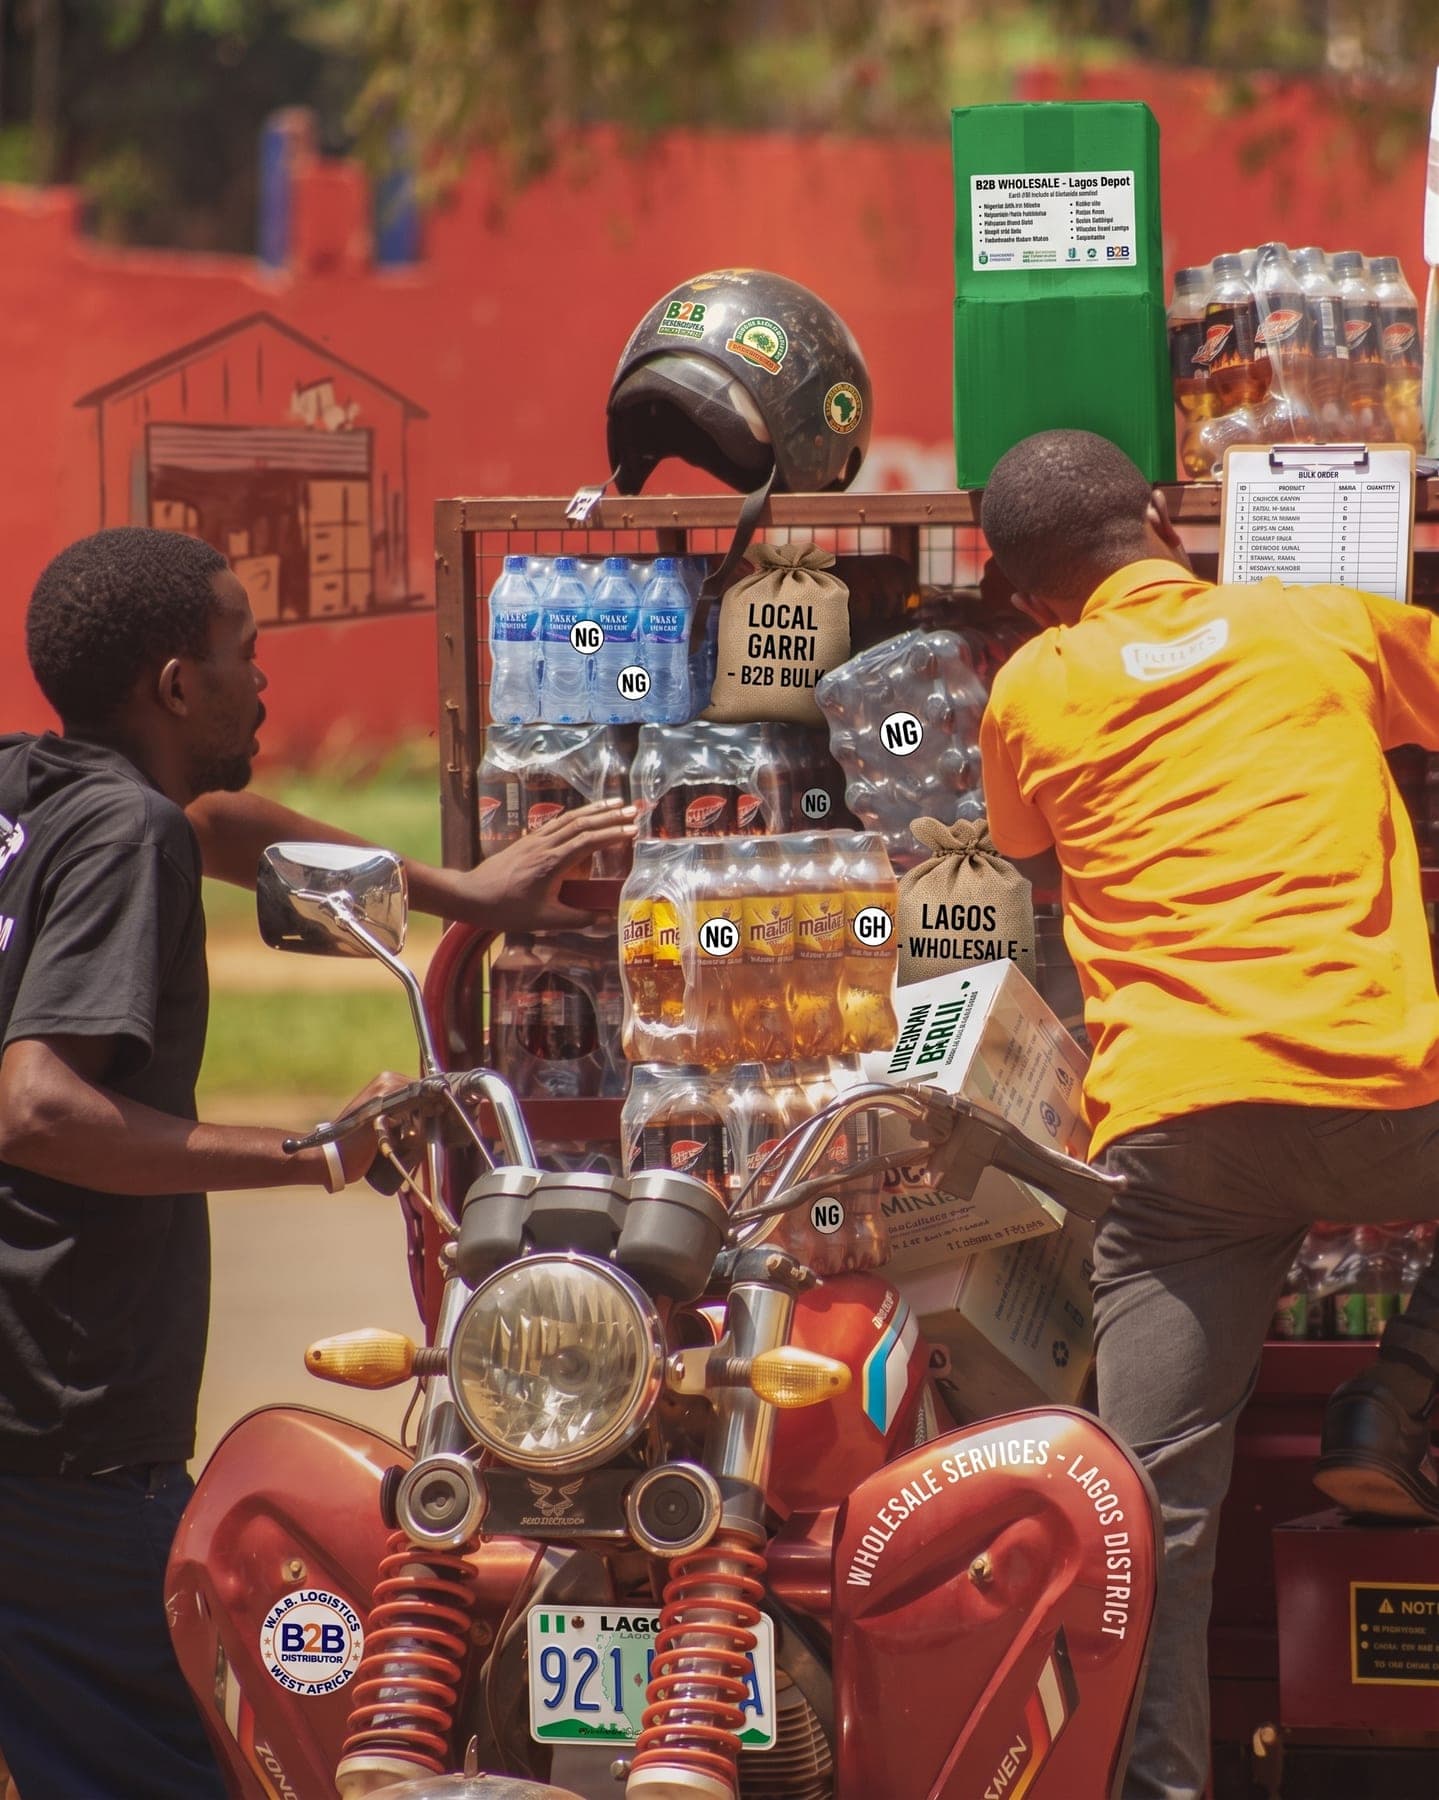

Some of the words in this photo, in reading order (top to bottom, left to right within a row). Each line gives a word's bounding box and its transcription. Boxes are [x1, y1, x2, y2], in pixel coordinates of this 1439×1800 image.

[976, 179, 996, 190] B2B
[998, 178, 1060, 189] WHOLESALE
[1069, 176, 1098, 188] Lagos
[1101, 176, 1130, 188] Depot
[1106, 246, 1130, 258] B2B
[666, 302, 706, 322] B2B
[748, 603, 818, 631] LOCAL
[575, 628, 599, 647] NG
[748, 634, 816, 662] GARRI
[622, 674, 646, 693] NG
[741, 666, 774, 686] B2B
[780, 667, 826, 688] BULK
[886, 720, 918, 749] NG
[805, 794, 827, 813] NG
[860, 916, 886, 938] GH
[922, 904, 996, 932] LAGOS
[706, 926, 733, 948] NG
[910, 937, 1018, 960] WHOLESALE
[815, 1206, 839, 1227] NG
[847, 1469, 943, 1587] WHOLESALE
[941, 1439, 1050, 1484] SERVICES
[1066, 1454, 1124, 1526] LAGOS
[1102, 1532, 1131, 1640] DISTRICT
[264, 1598, 298, 1629] W.A.B.
[300, 1592, 360, 1632] LOGISTICS
[600, 1616, 662, 1632] LAGO
[282, 1623, 345, 1653] B2B
[282, 1654, 343, 1664] DISTRIBUTOR
[271, 1665, 305, 1692] WEST
[307, 1669, 353, 1694] AFRICA
